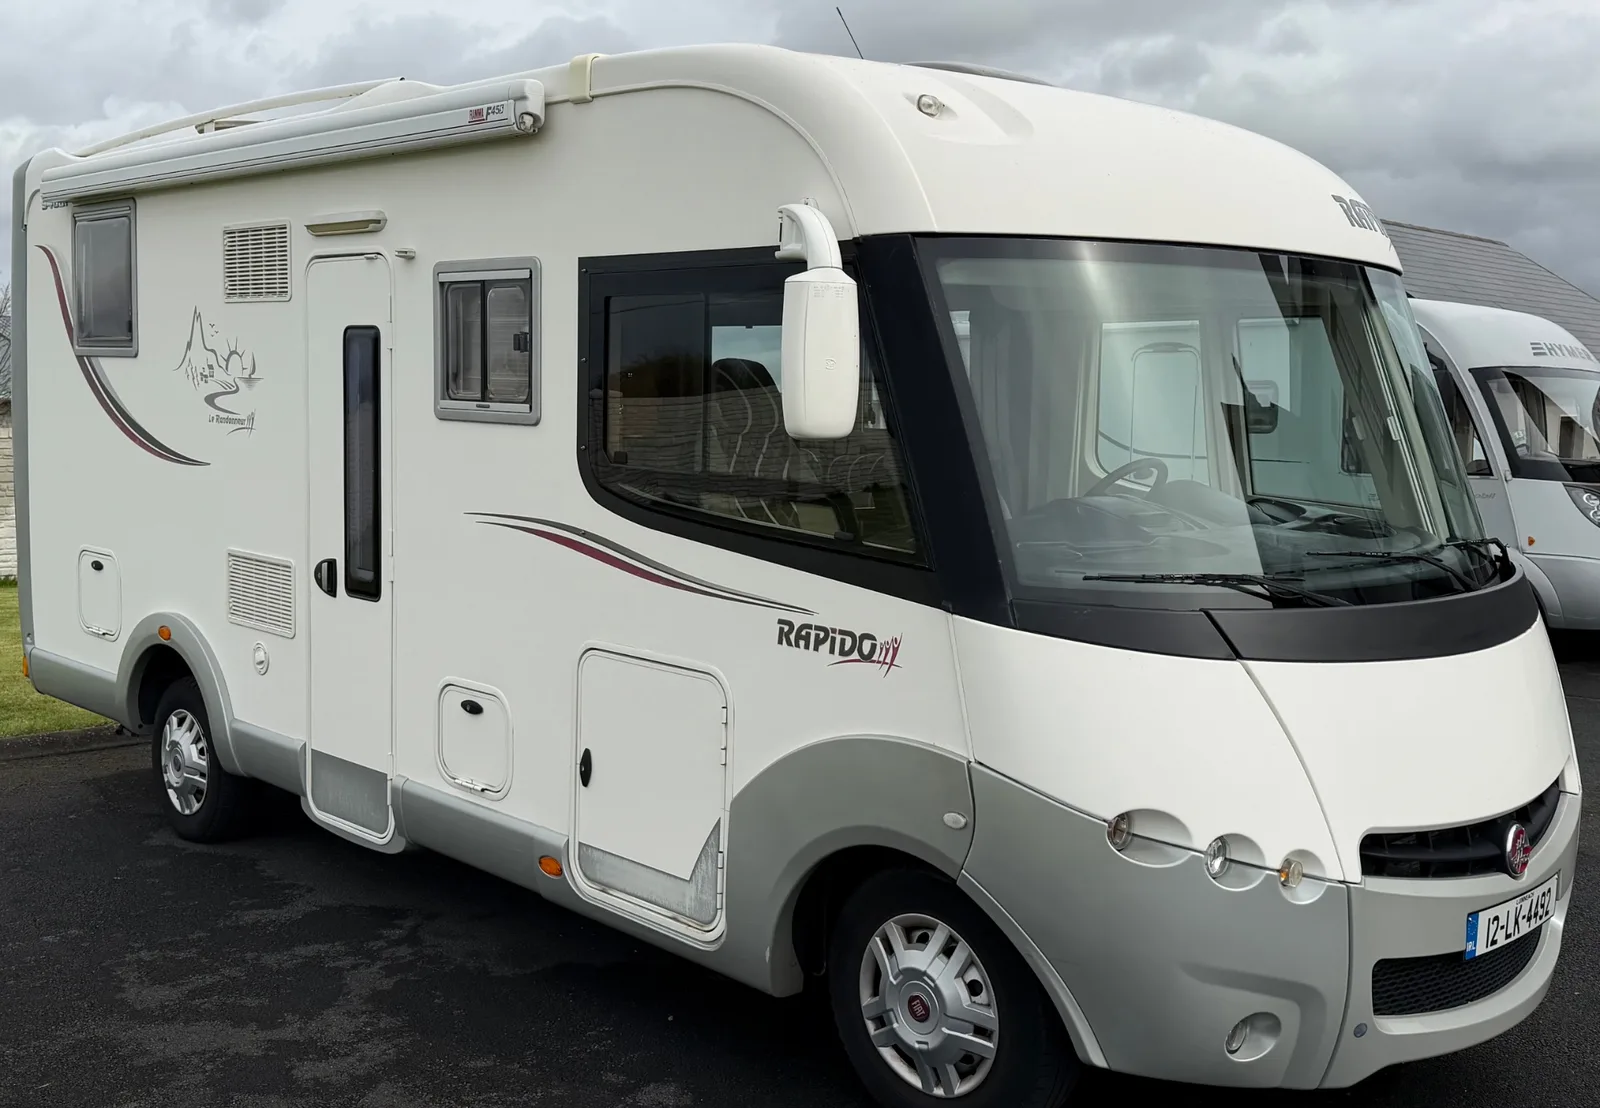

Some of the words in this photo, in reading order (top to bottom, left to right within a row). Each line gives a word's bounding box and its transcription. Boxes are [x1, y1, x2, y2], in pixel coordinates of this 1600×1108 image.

[208, 414, 215, 423] Le
[1485, 887, 1552, 949] 12-LK-4492
[1466, 941, 1476, 952] IRL
[911, 999, 926, 1017] FIAT
